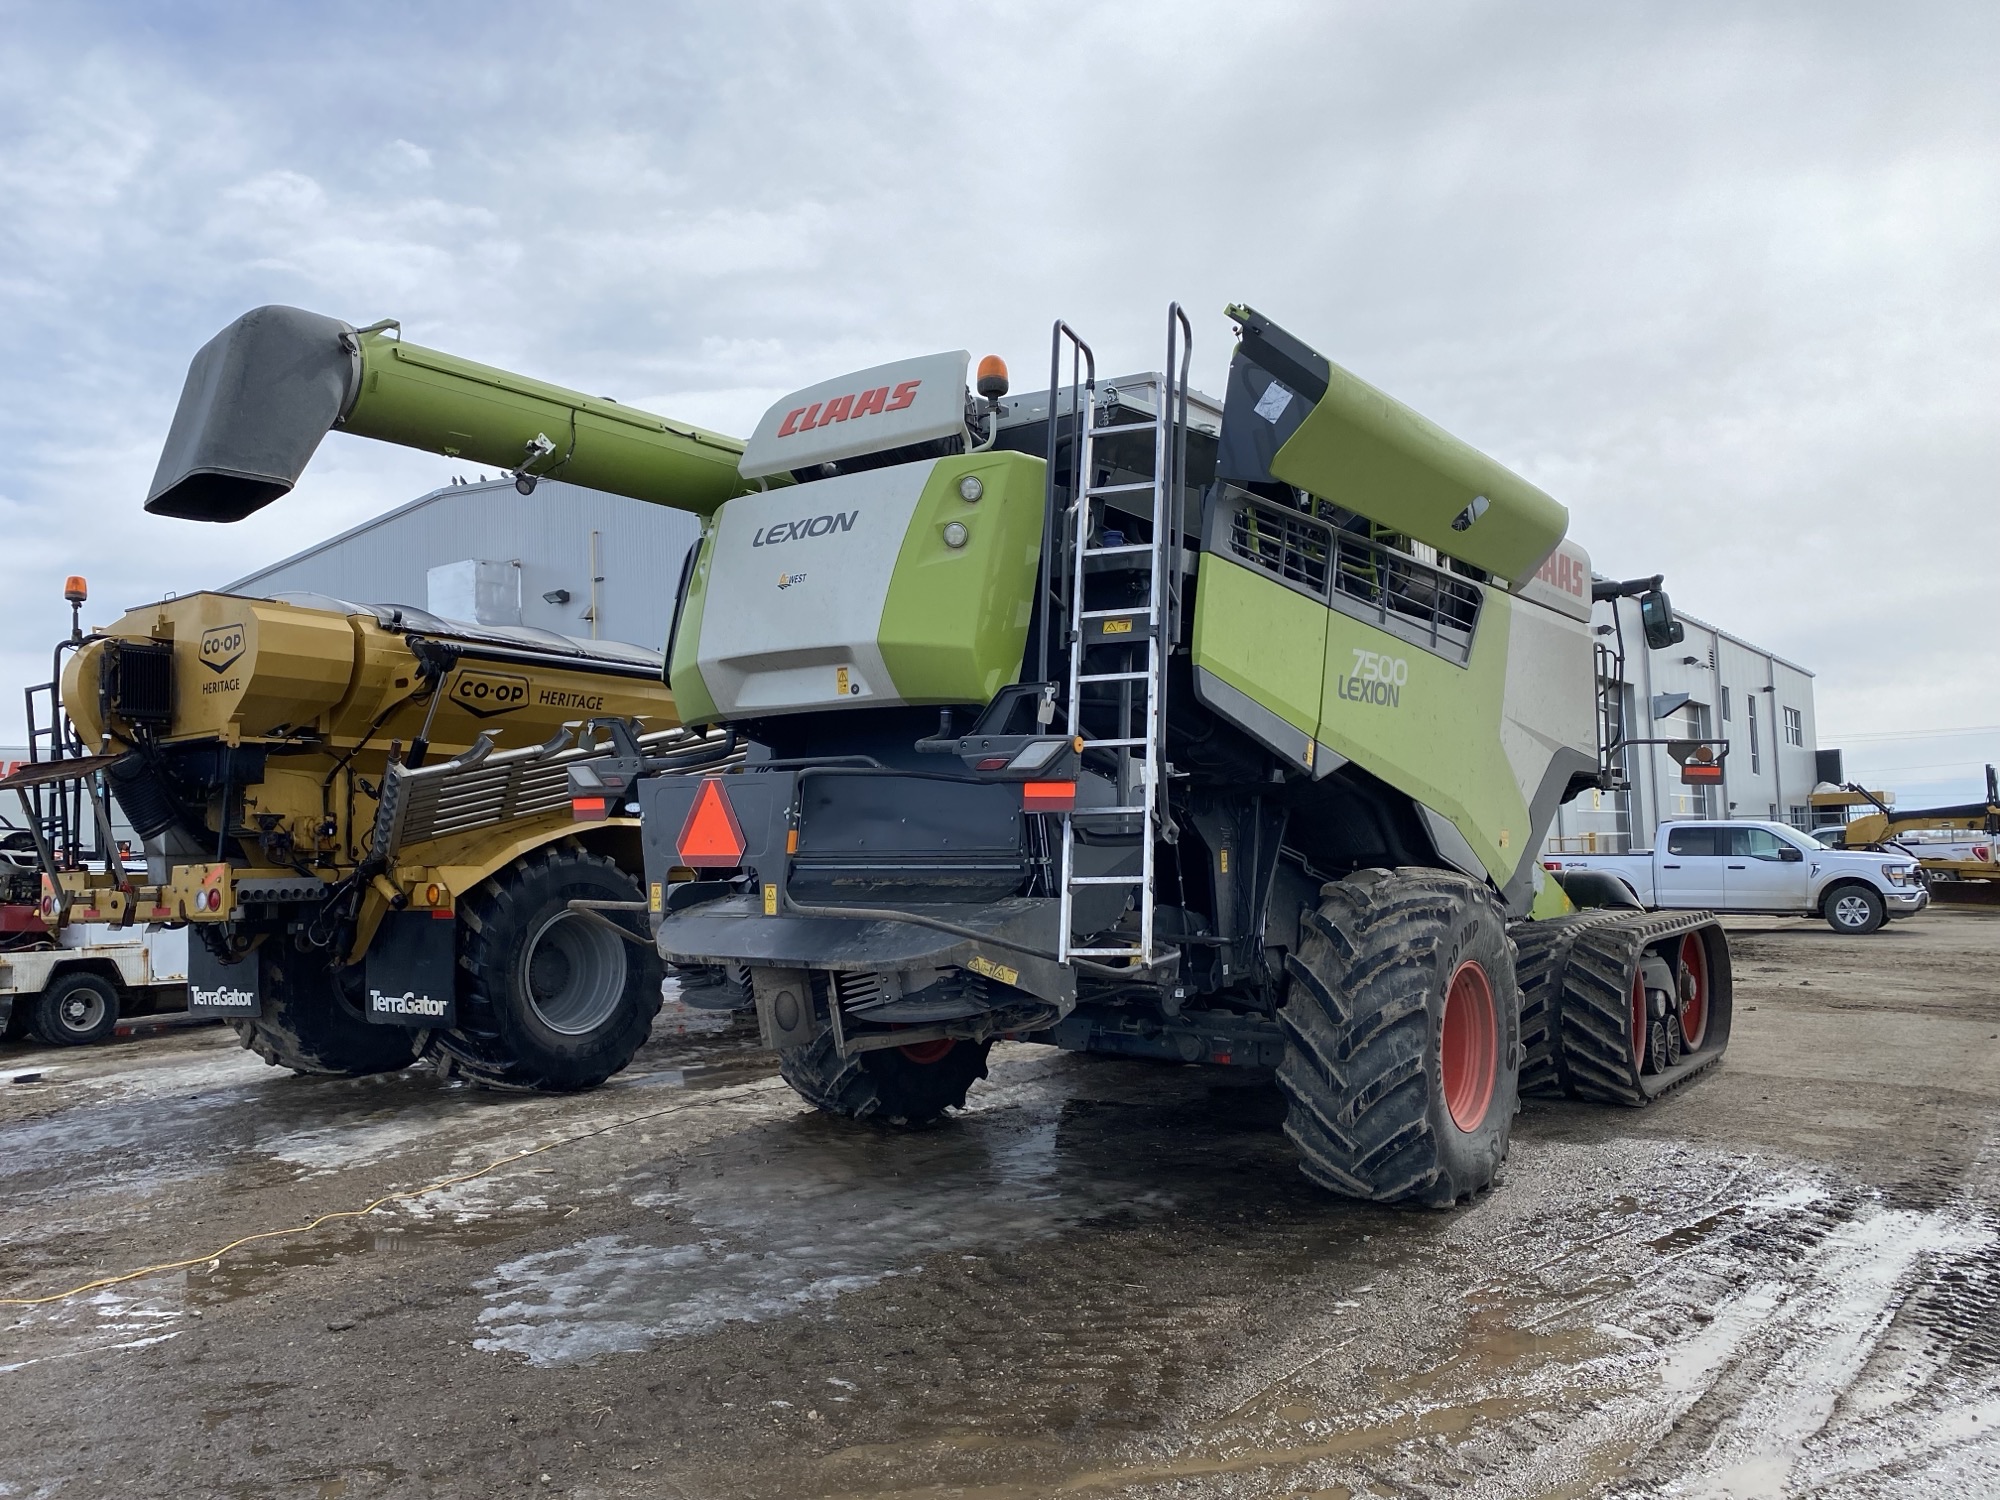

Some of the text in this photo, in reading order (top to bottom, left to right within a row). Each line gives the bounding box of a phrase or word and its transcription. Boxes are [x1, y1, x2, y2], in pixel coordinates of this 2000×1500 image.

[777, 380, 922, 438] CLAAS
[752, 510, 860, 548] LEXION
[1535, 550, 1583, 598] AAS
[1351, 648, 1409, 687] 7500
[202, 678, 240, 695] HERITAGE
[539, 690, 604, 711] HERITAGE
[1338, 674, 1400, 708] LEXION
[1460, 919, 1479, 950] IMP
[190, 985, 254, 1006] TerraGator
[369, 989, 449, 1017] TerraGator
